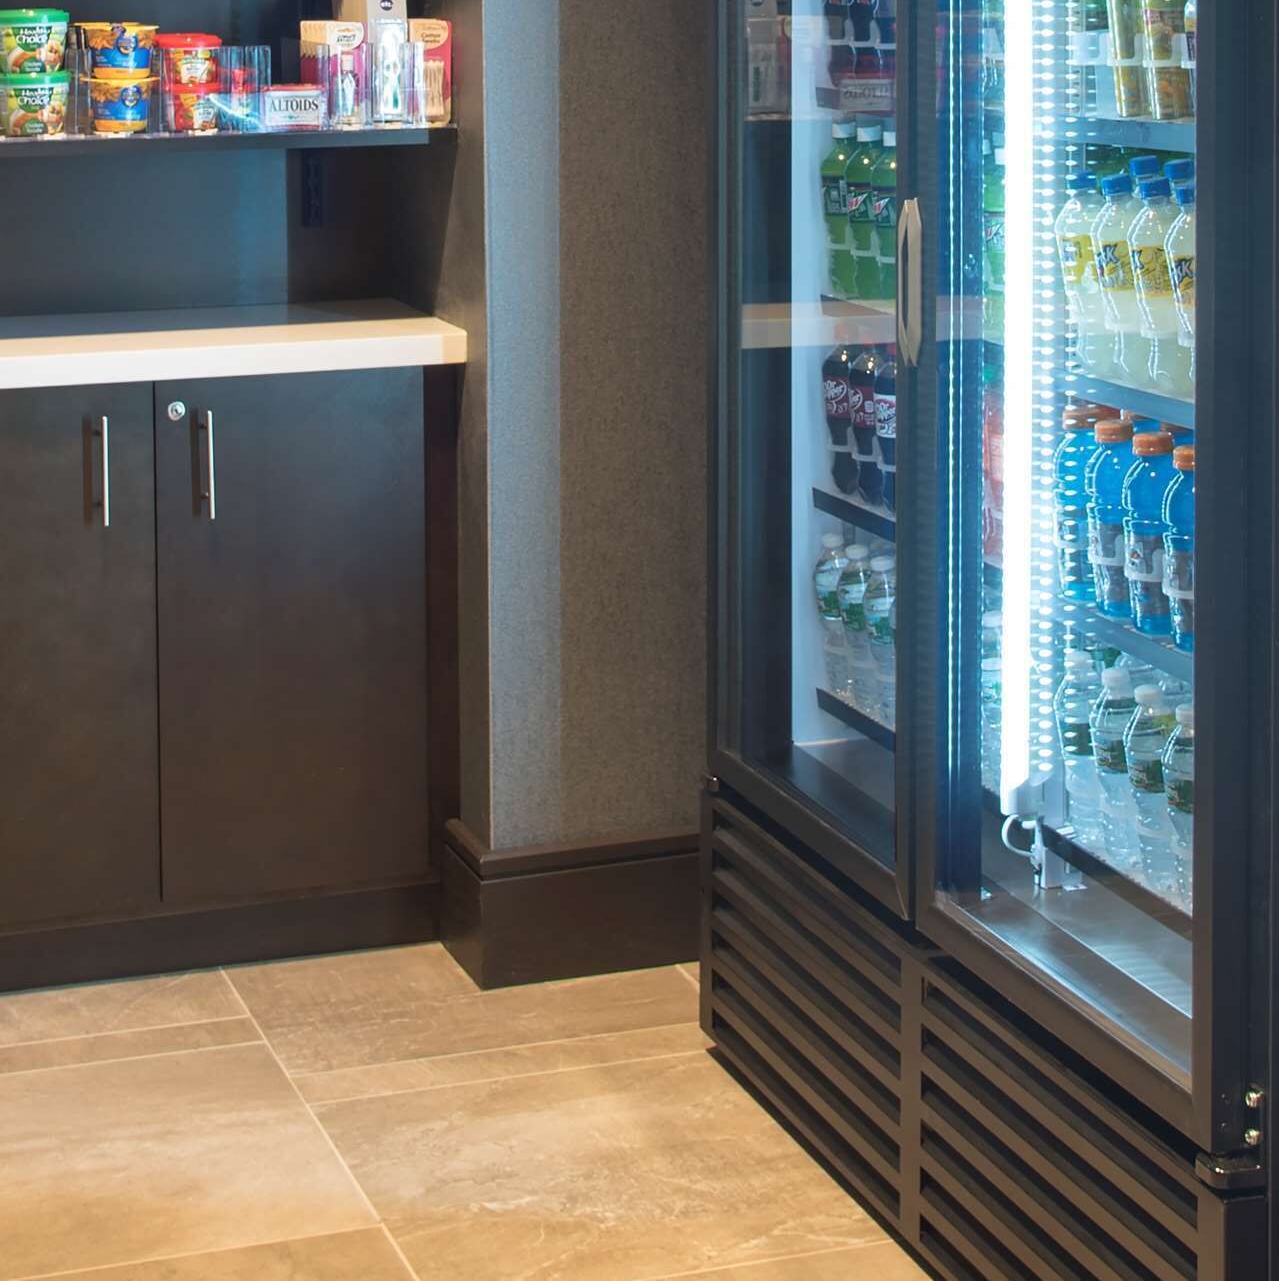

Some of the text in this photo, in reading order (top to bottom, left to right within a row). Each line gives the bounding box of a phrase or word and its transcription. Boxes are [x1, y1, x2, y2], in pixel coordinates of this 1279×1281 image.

[15, 32, 49, 45] Choice
[17, 94, 50, 107] Choice
[270, 97, 320, 112] ALTOIDS
